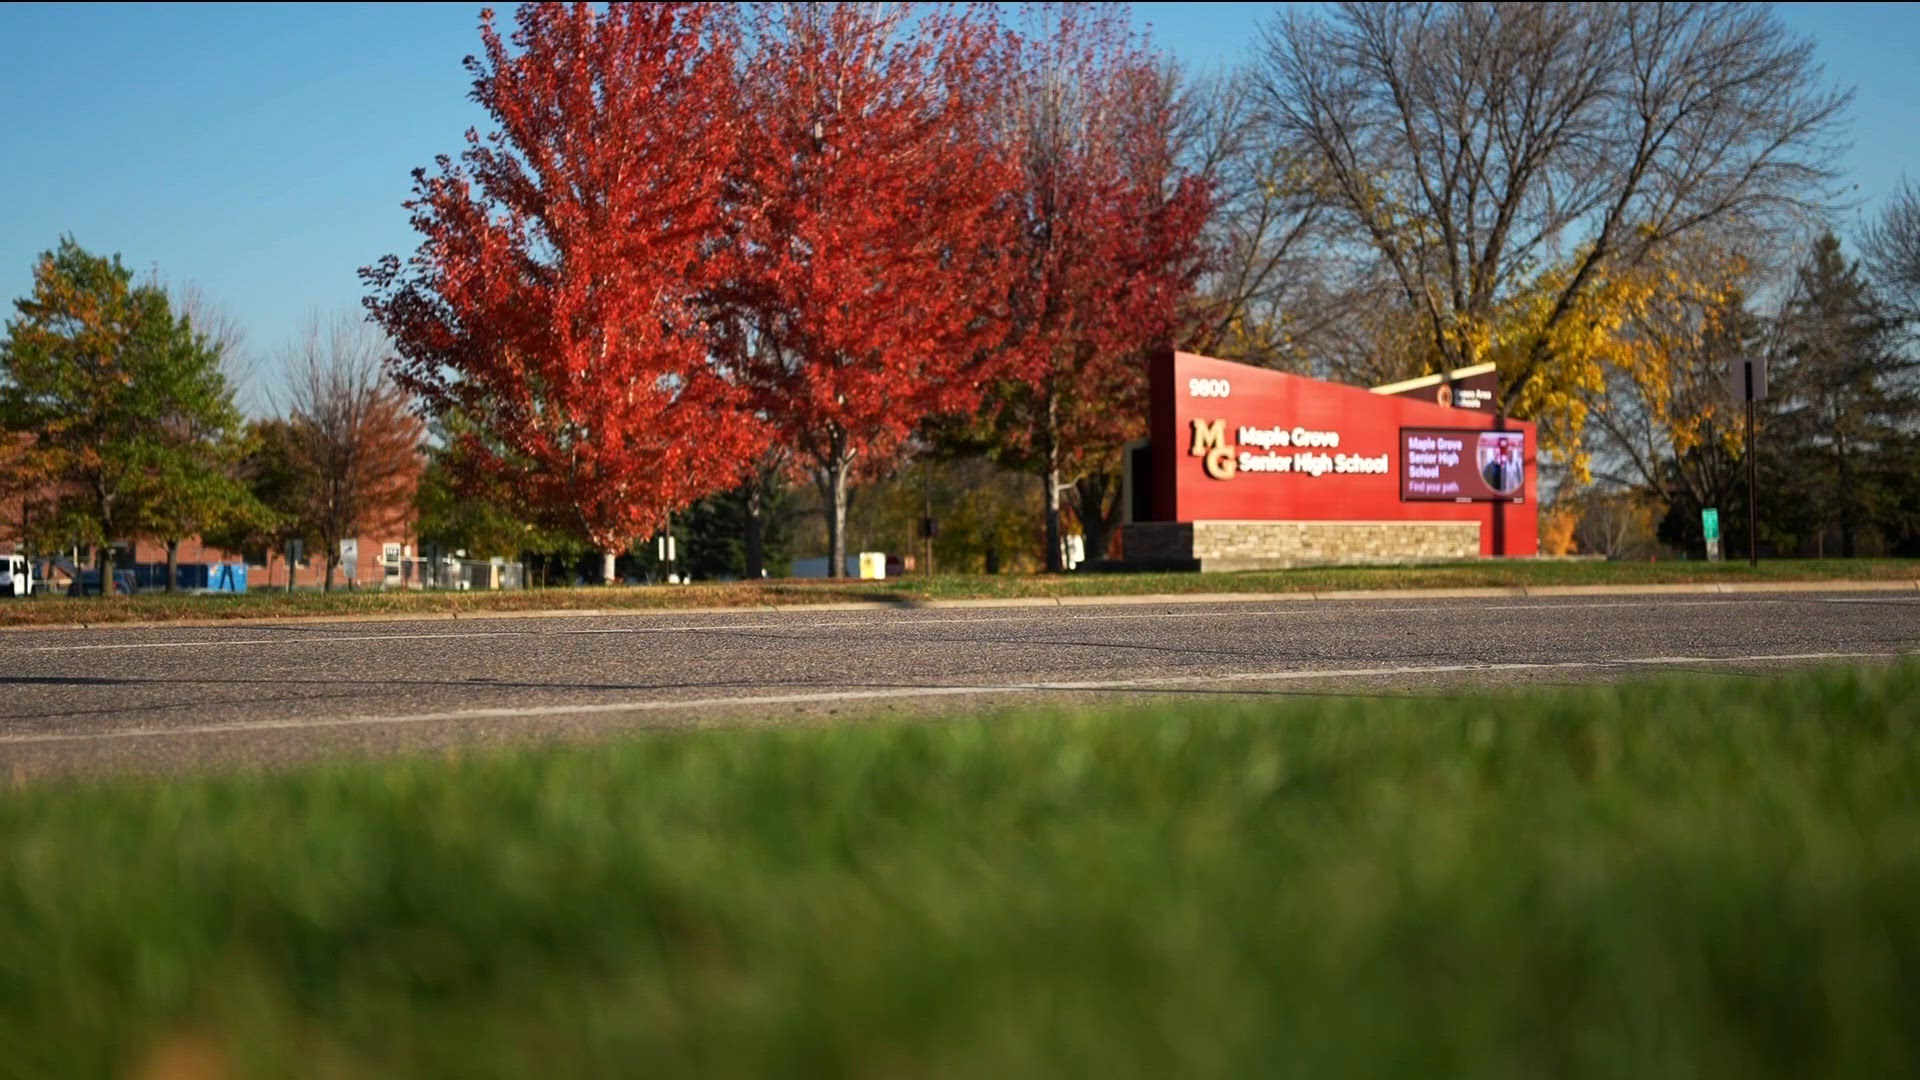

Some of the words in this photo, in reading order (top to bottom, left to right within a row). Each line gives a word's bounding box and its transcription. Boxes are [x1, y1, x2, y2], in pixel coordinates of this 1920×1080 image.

[1189, 378, 1230, 397] 9800
[1239, 426, 1290, 449] Maple
[1291, 427, 1340, 448] Grove
[1408, 437, 1436, 452] Maple
[1437, 438, 1463, 451] Grove
[1239, 451, 1292, 472] Senior
[1294, 452, 1333, 477] High
[1335, 454, 1389, 473] School
[1408, 451, 1437, 464] Senior
[1438, 452, 1459, 467] High
[1408, 465, 1439, 478] School
